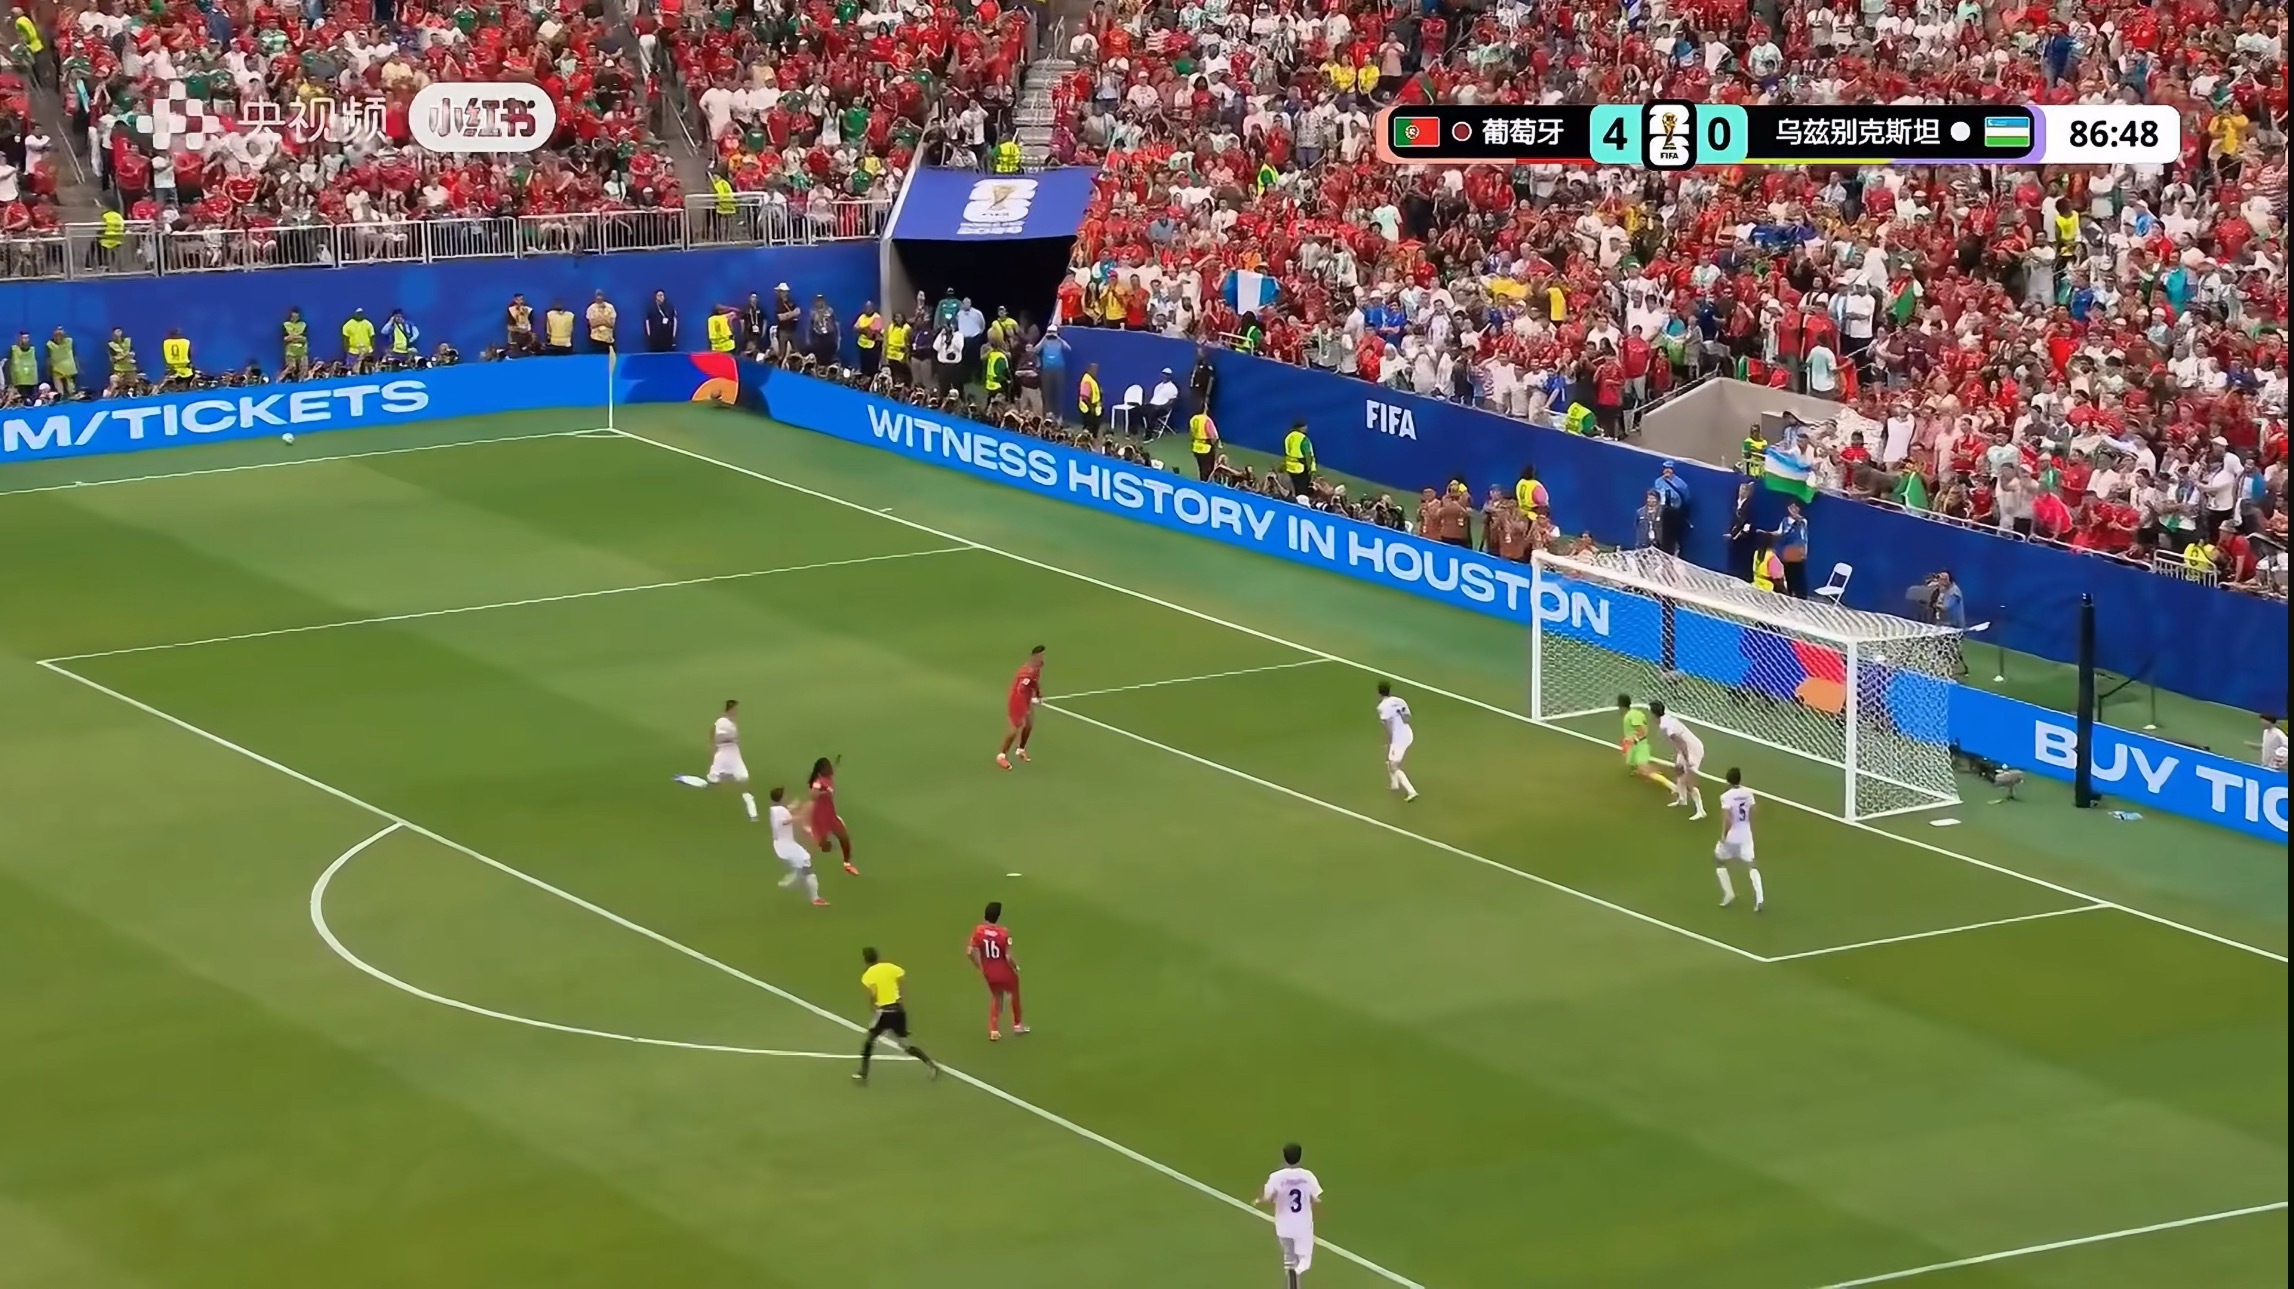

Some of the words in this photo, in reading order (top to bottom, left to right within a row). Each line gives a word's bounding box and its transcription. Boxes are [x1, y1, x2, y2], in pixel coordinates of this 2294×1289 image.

[3, 380, 429, 453] M/TICKETS
[1366, 399, 1418, 441] FIFA
[866, 403, 1059, 487] WITNESS
[1068, 459, 1275, 541] HISTORY
[1287, 514, 1335, 560] IN
[1348, 530, 1610, 636] HOUSTON
[2035, 719, 2180, 794] BUY
[1739, 801, 1746, 822] 5
[983, 938, 1000, 959] 16
[1289, 1188, 1302, 1213] 3
